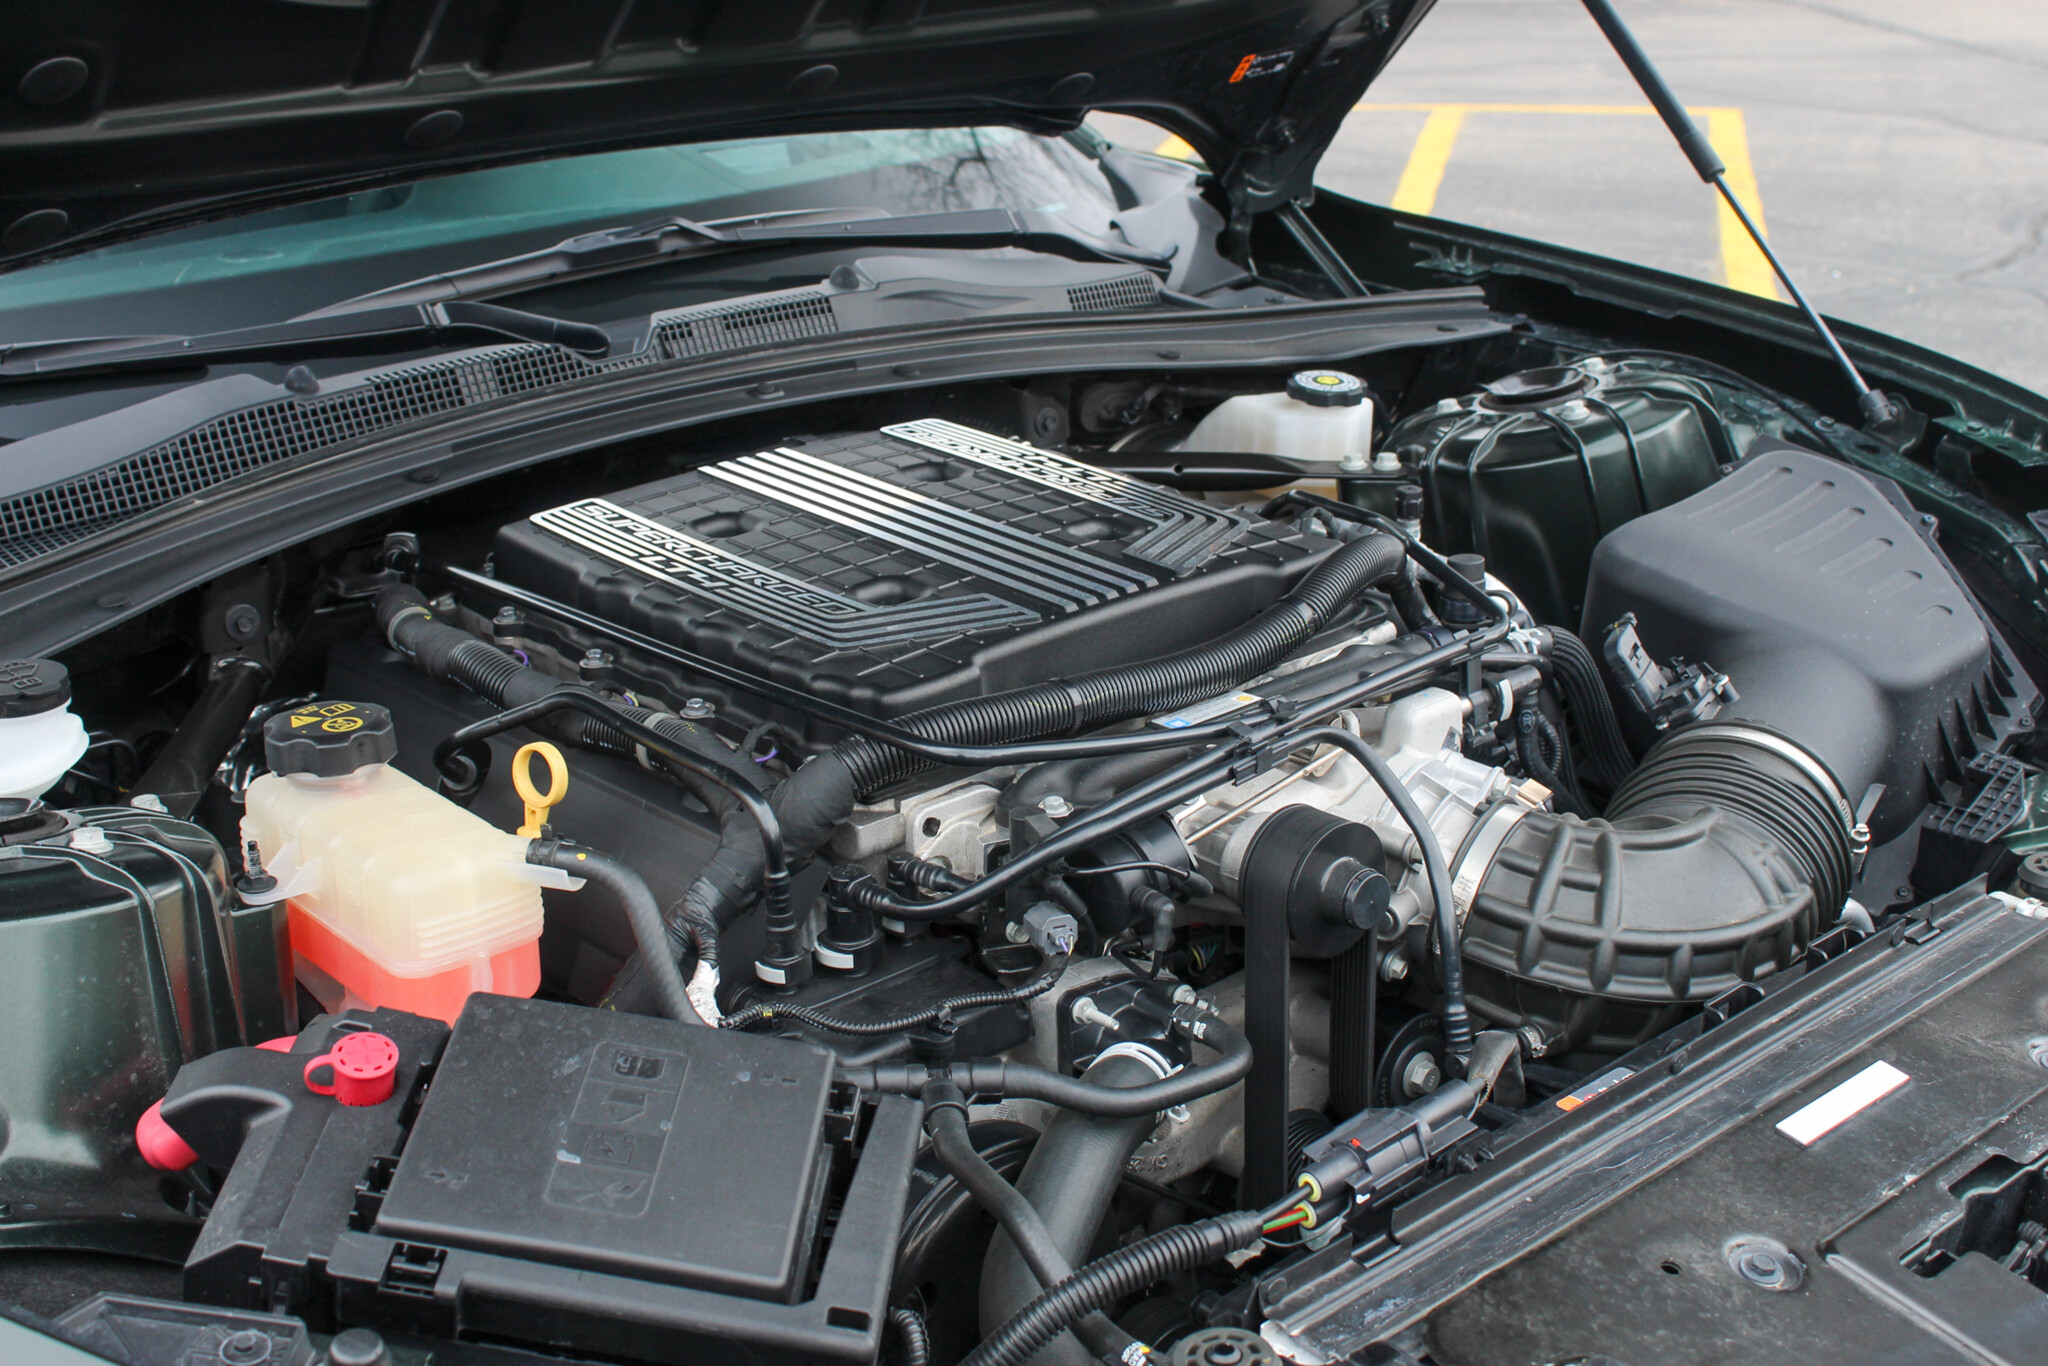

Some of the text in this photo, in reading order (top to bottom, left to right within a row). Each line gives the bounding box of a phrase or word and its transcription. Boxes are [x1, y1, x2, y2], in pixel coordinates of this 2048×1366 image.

[897, 426, 1166, 517] SUPERCHARGED
[576, 503, 858, 615] SUPERCHARGED
[639, 554, 729, 588] LT4
